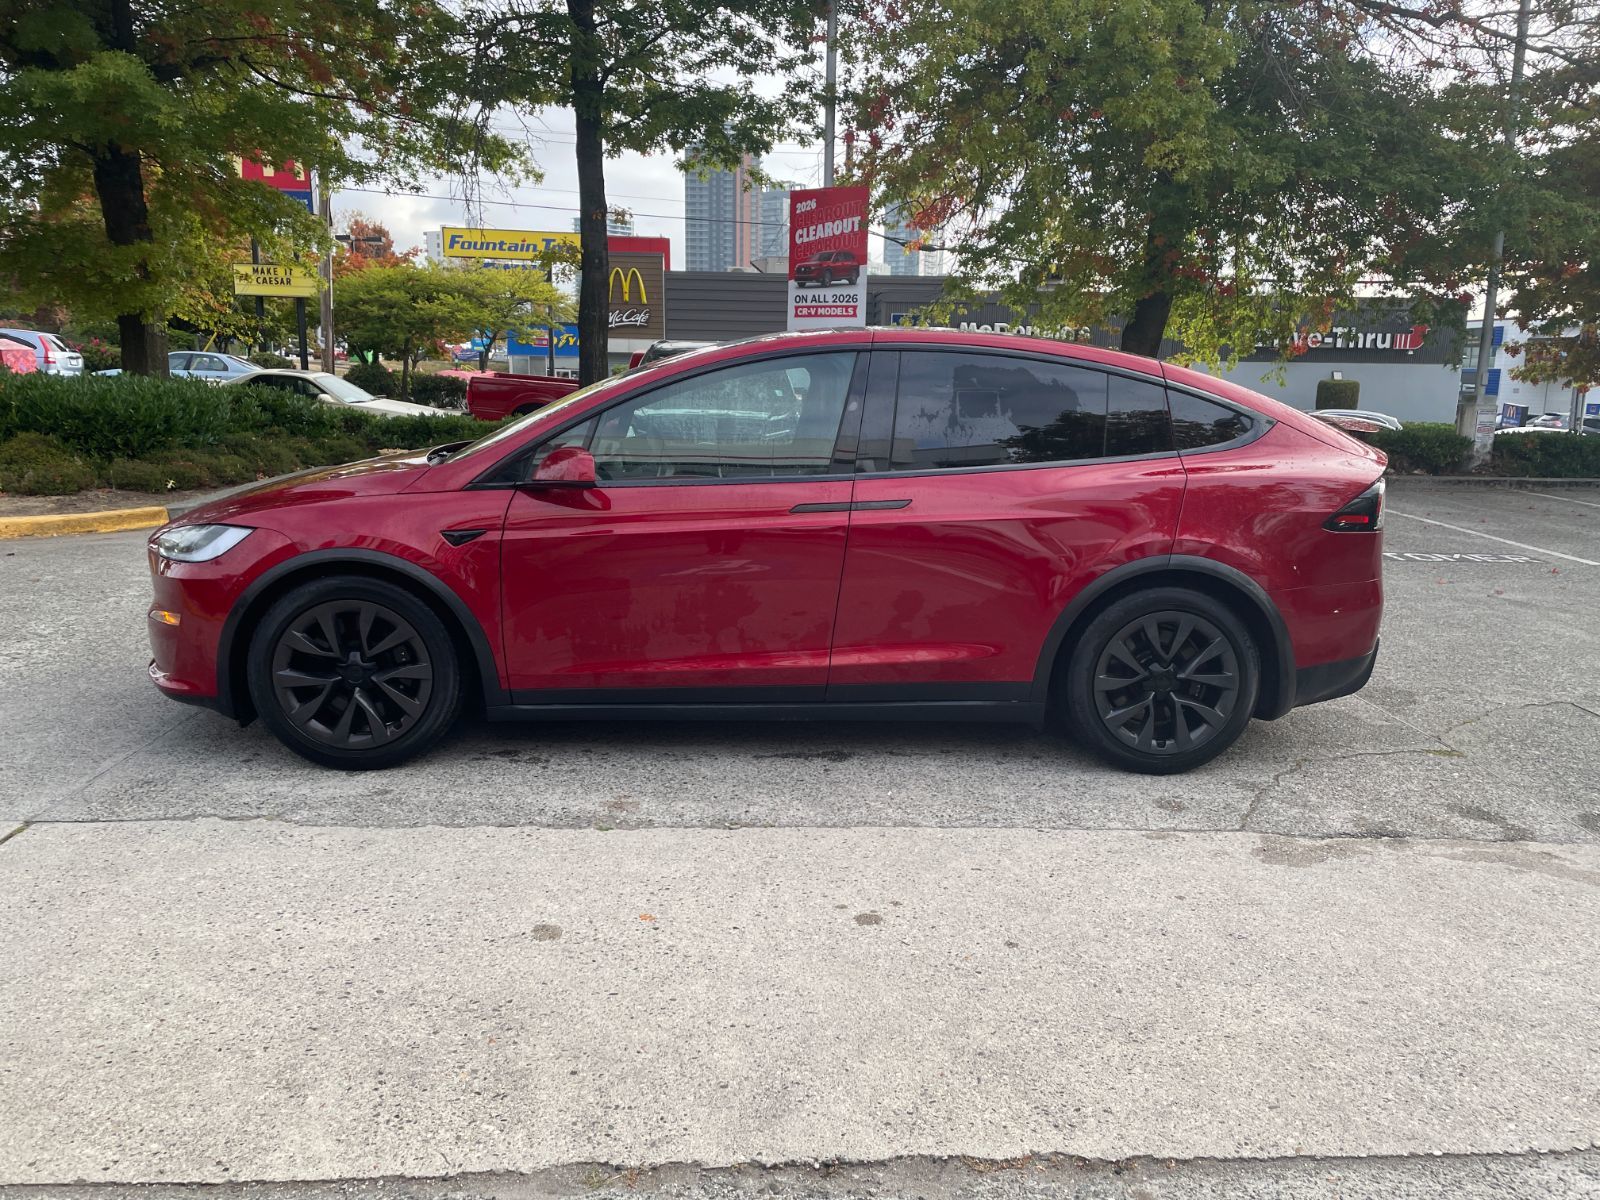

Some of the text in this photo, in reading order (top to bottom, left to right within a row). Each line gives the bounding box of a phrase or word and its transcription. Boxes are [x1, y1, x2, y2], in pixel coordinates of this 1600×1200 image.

[796, 199, 817, 214] 2026
[795, 216, 862, 244] CLEAROUT
[449, 235, 538, 253] Fountain
[253, 267, 293, 276] MAKE IT
[256, 277, 292, 286] CAESAR
[795, 294, 858, 304] ON ALL 2026
[797, 306, 854, 316] CR-V MODELS
[960, 322, 1091, 341] McDonlds
[1254, 326, 1392, 349] ve-Thru
